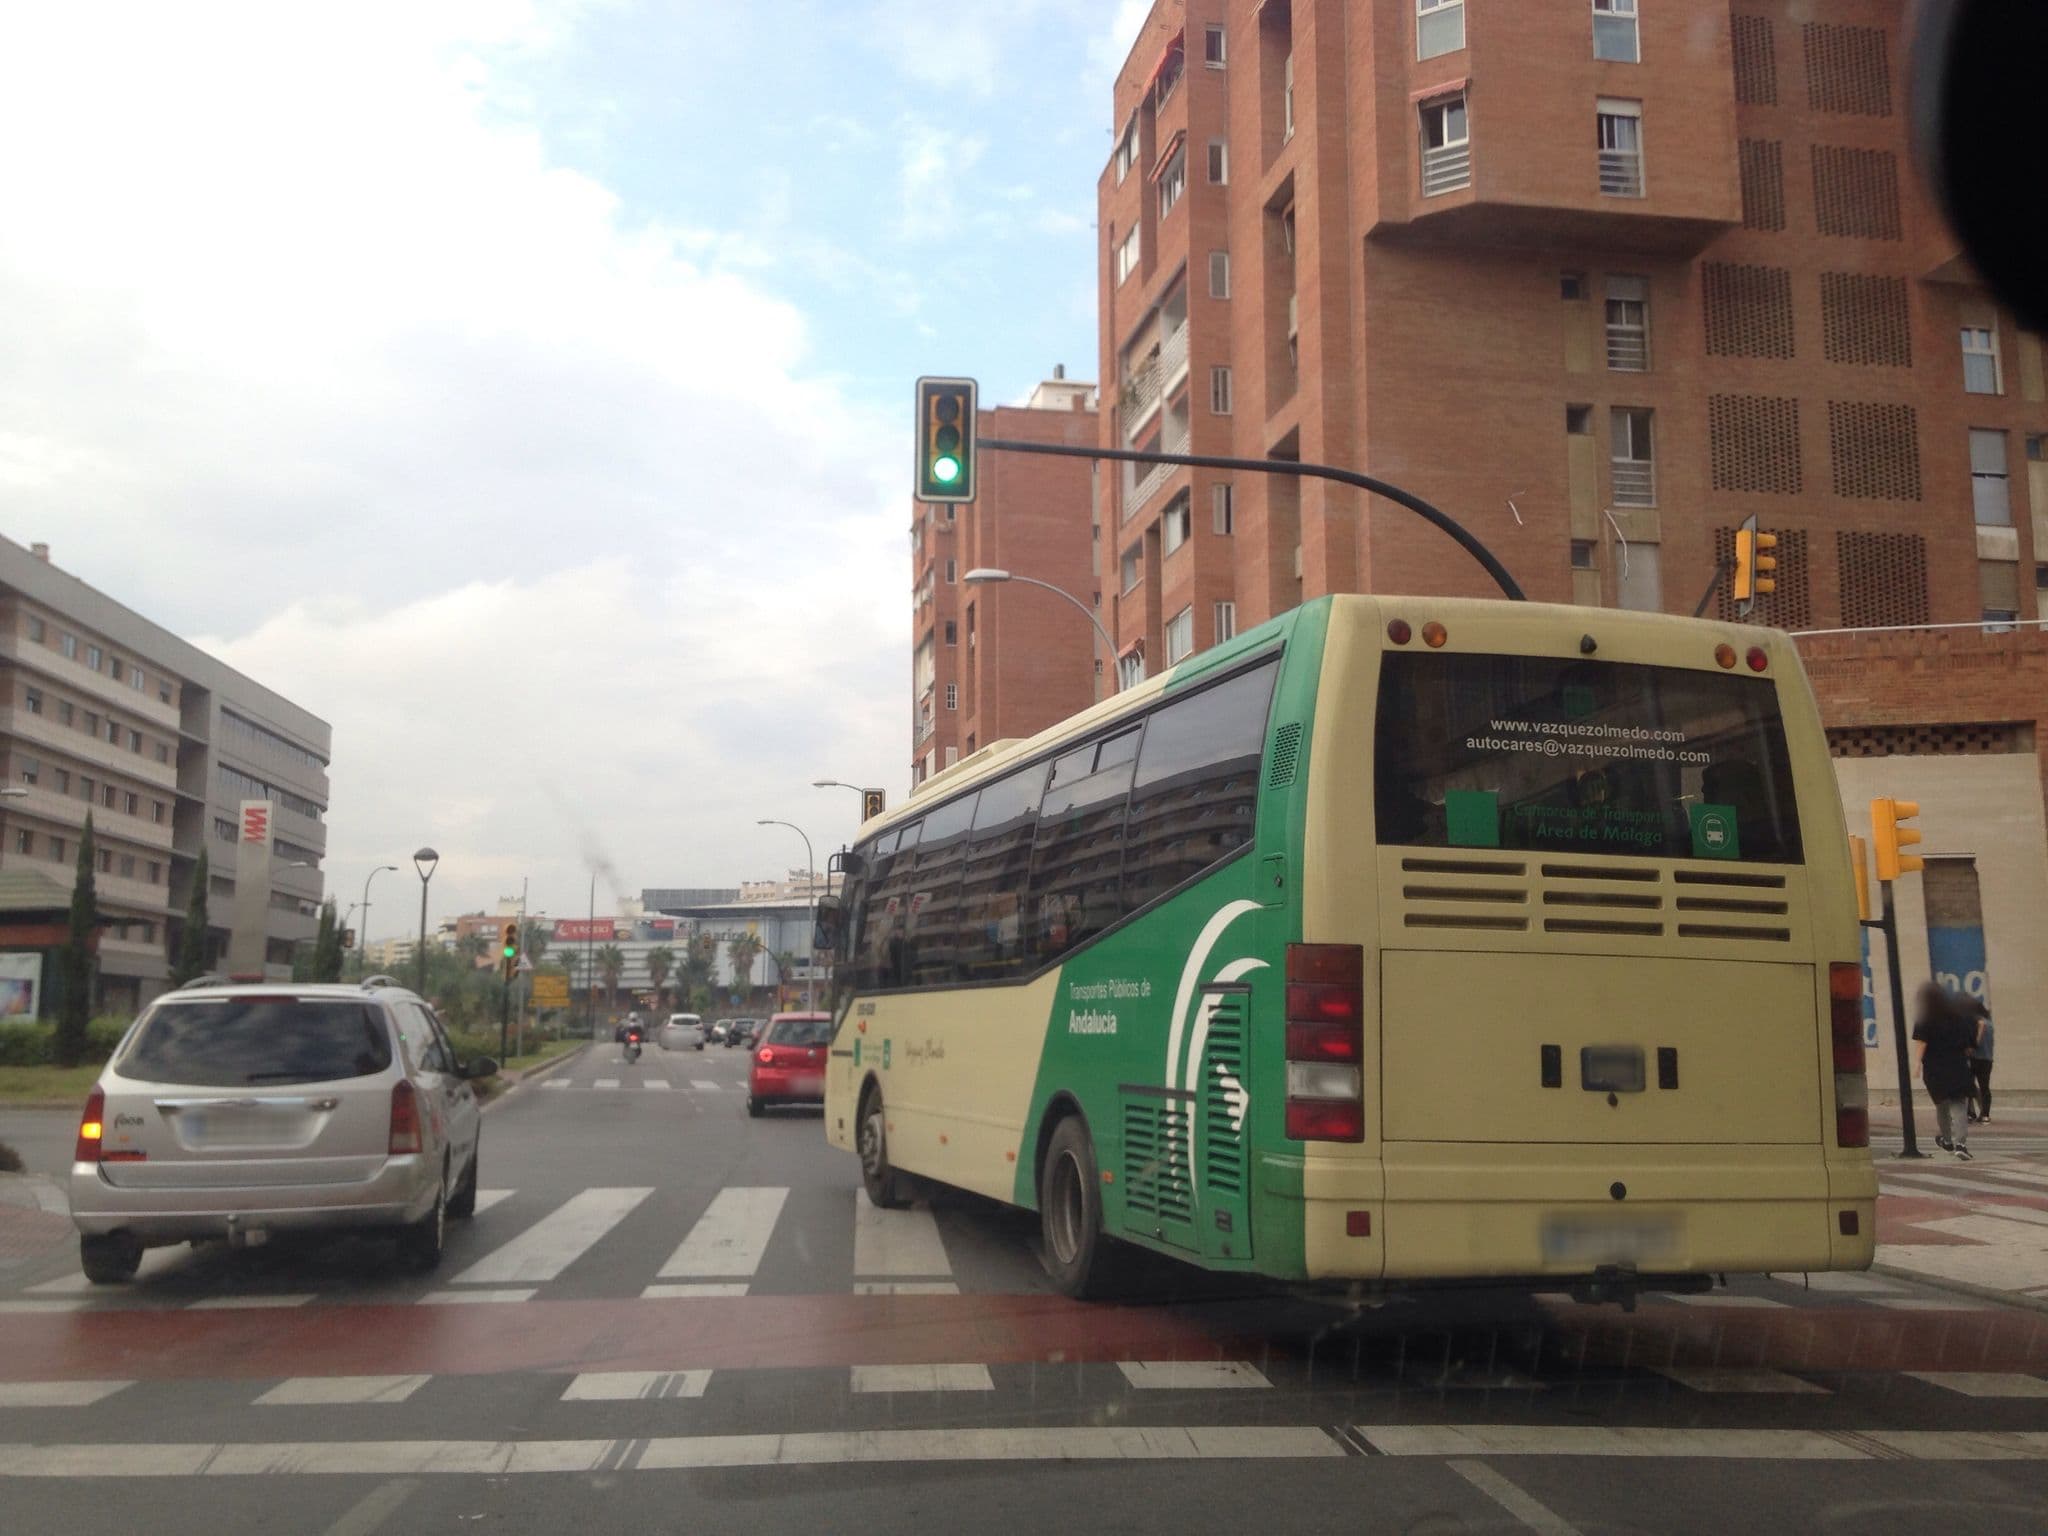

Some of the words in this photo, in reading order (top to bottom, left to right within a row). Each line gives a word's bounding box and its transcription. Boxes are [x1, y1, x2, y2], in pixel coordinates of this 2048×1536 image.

[1490, 719, 1685, 742] www.vazquezolmedo.com
[1466, 736, 1711, 763] autocares@vazquezolmedo.com
[1579, 823, 1598, 839] de
[1070, 981, 1108, 1002] Transportes
[1140, 977, 1152, 997] de
[1069, 1008, 1117, 1034] Andalucía
